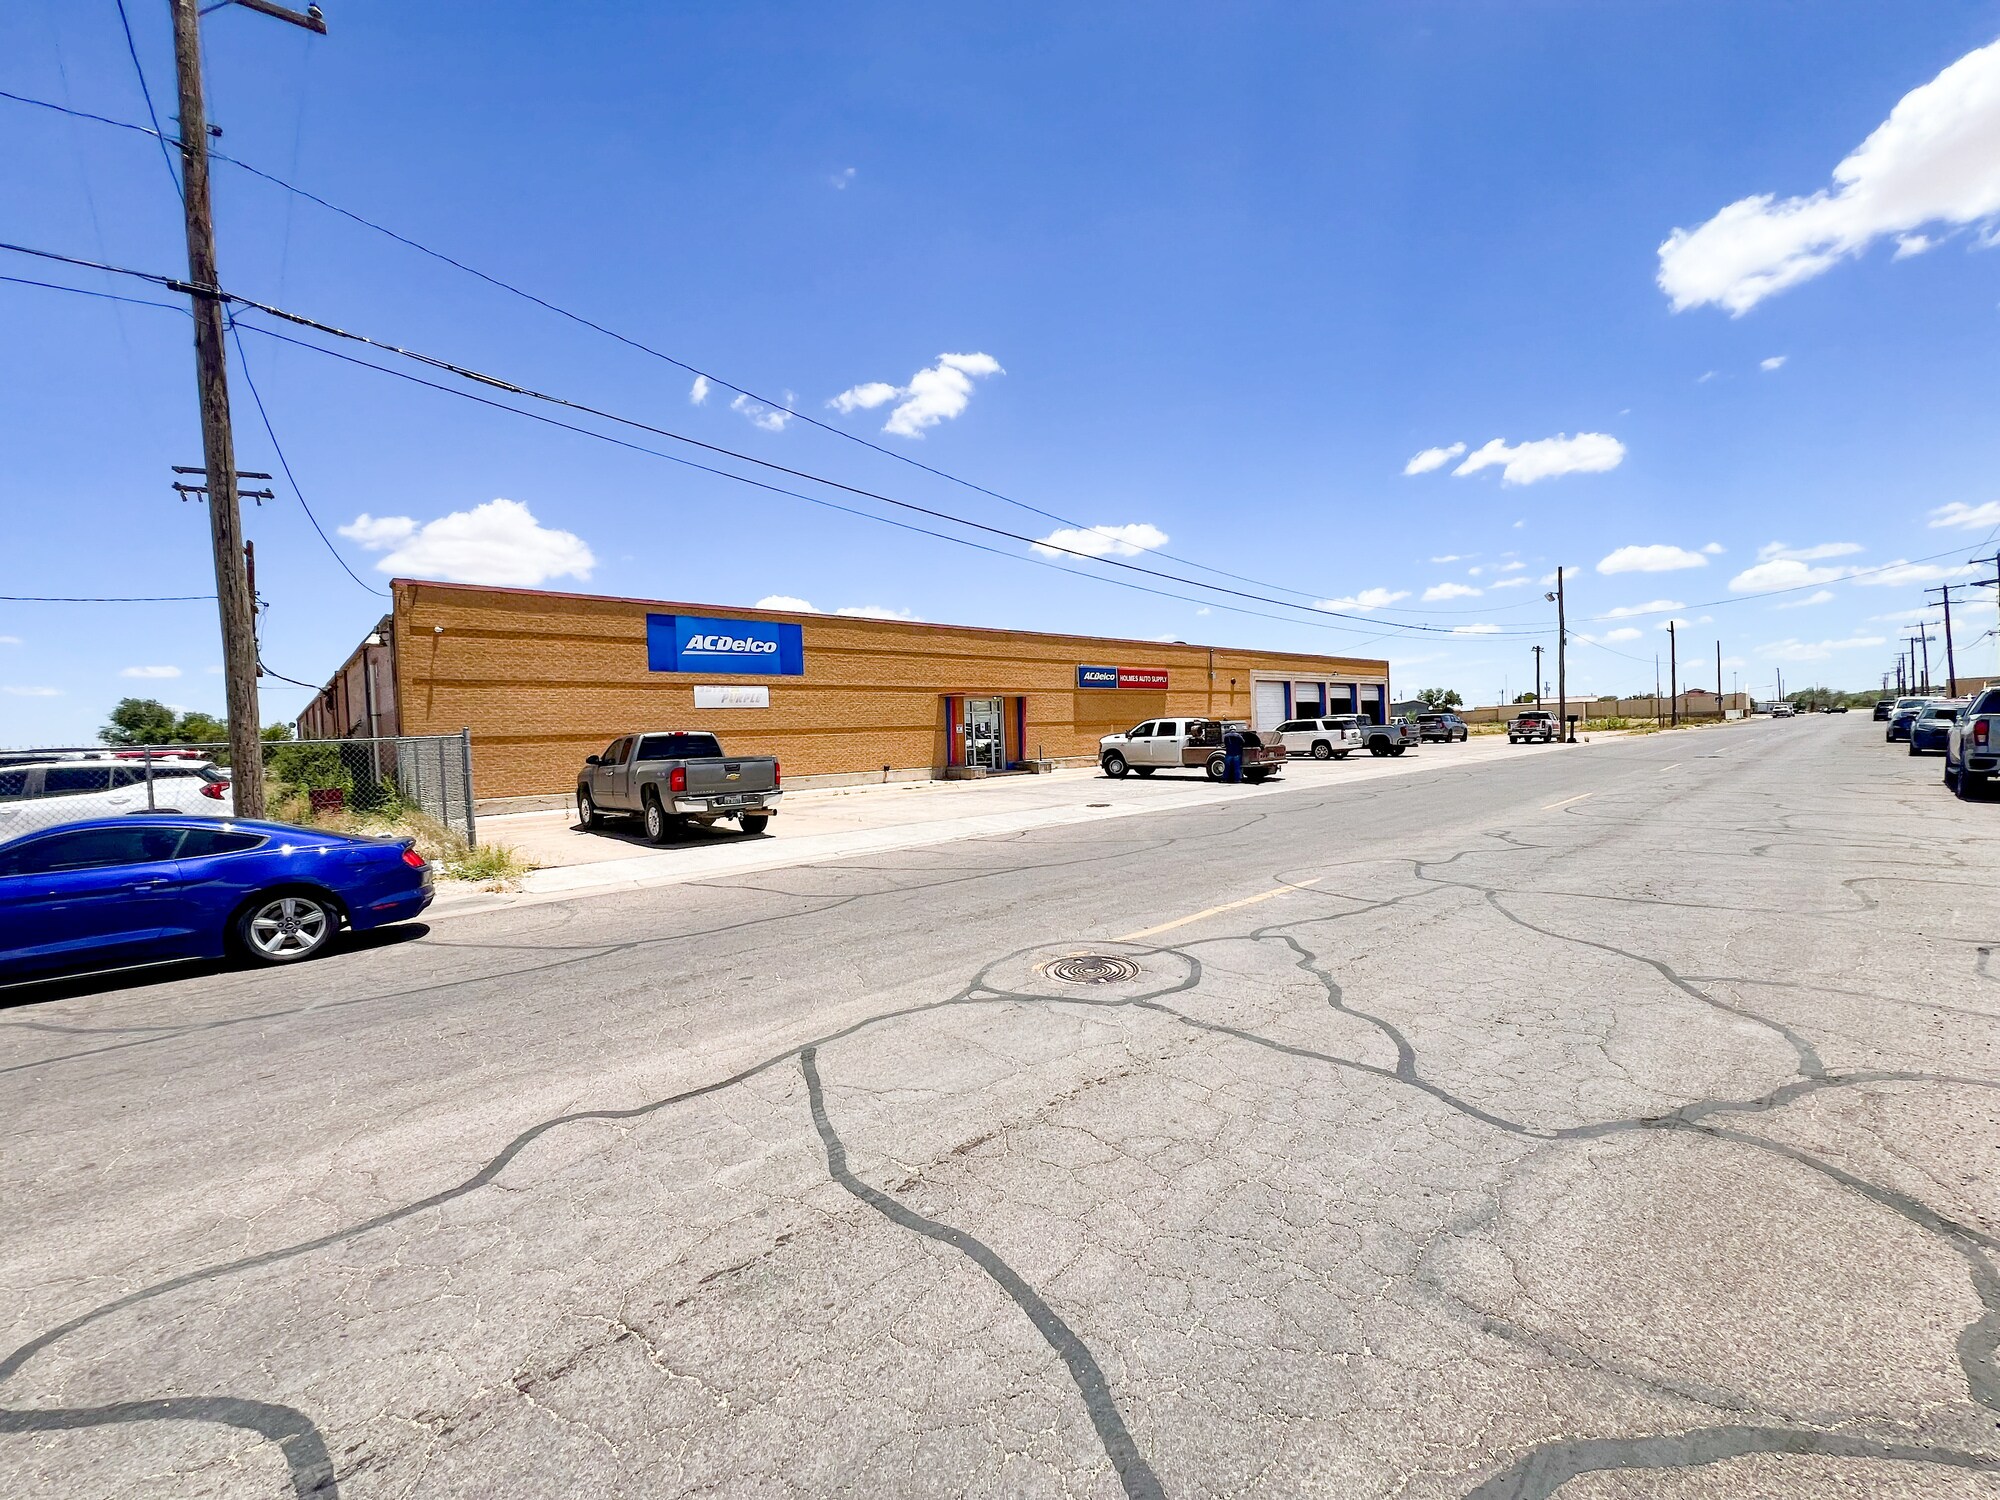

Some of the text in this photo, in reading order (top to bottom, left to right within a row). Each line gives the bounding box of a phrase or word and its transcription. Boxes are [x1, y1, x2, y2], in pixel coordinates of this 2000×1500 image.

[686, 634, 777, 653] ACDelco
[1083, 672, 1115, 681] ACDelco
[1119, 674, 1139, 682] HOLMES
[1152, 675, 1167, 683] SUPPLY
